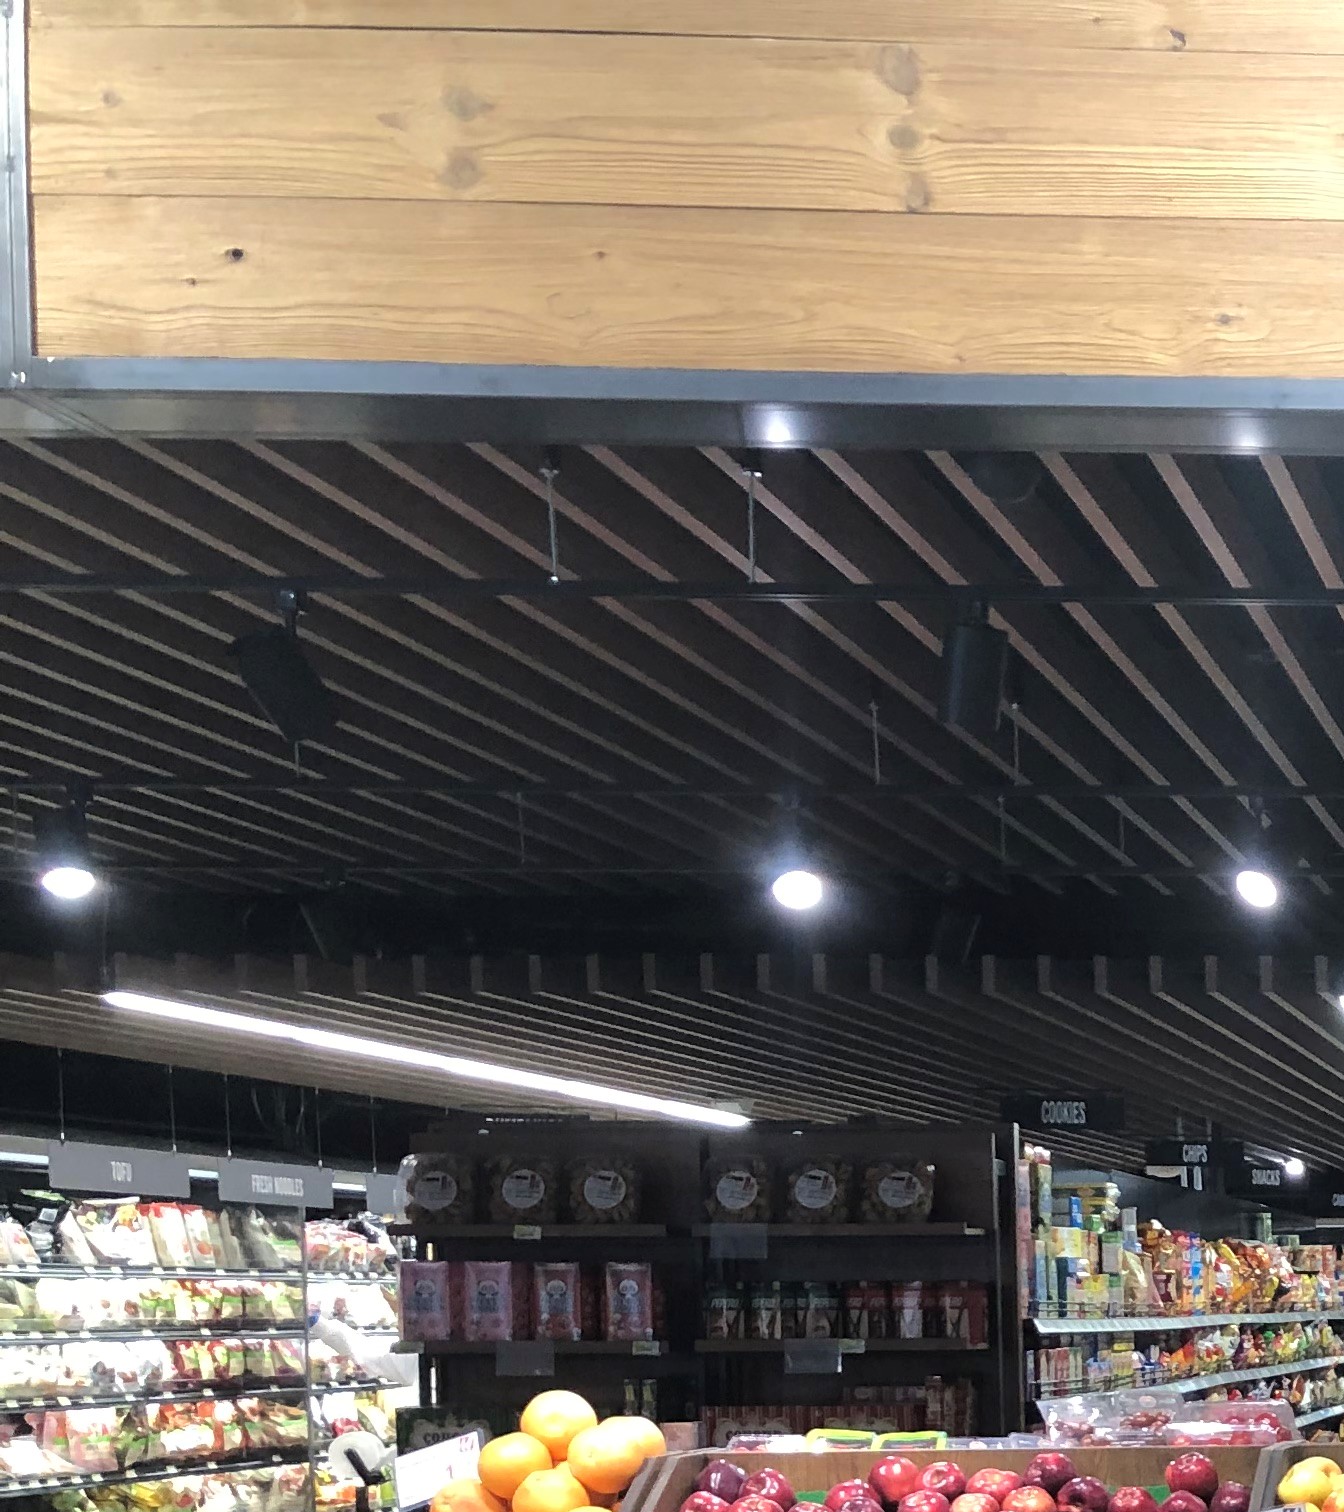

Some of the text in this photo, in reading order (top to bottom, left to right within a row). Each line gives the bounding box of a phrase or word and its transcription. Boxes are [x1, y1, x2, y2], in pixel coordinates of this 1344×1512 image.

[1041, 1100, 1086, 1124] COOKIES
[1182, 1144, 1207, 1163] CHIPS
[110, 1161, 132, 1182] TOFU
[1252, 1168, 1280, 1186] SNACKS
[251, 1174, 304, 1197] FRESH NOODLES
